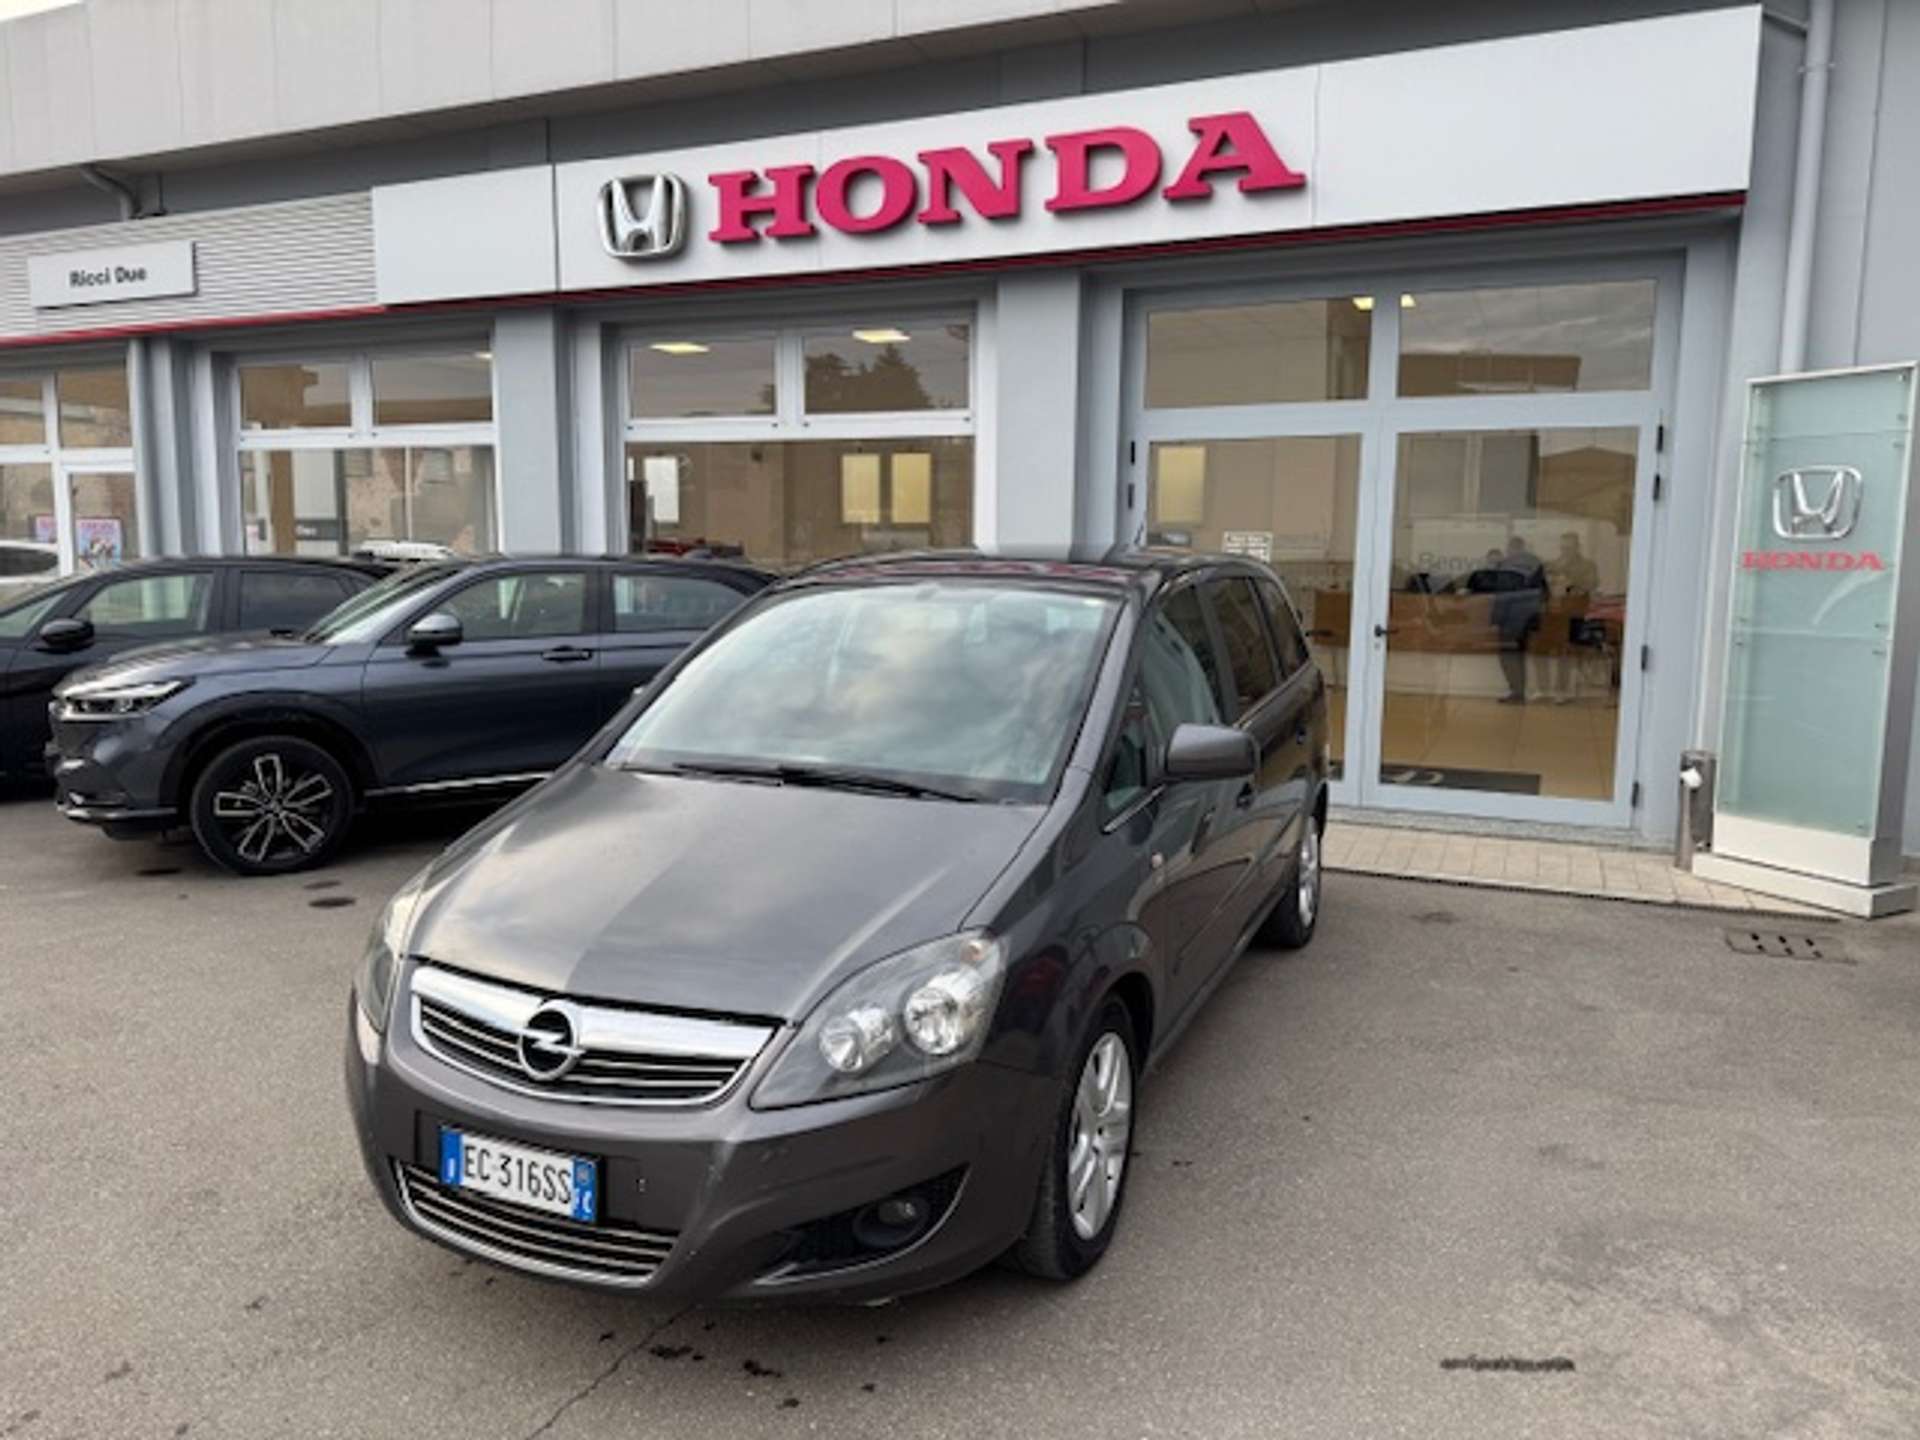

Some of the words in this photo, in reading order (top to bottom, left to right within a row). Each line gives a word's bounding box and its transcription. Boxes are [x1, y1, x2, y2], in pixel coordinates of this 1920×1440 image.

[708, 111, 1308, 244] HONDA
[69, 266, 111, 288] Ricci
[114, 266, 147, 284] Due
[1742, 550, 1886, 572] HONDA
[463, 1145, 491, 1182] EC
[498, 1154, 573, 1205] 316SS
